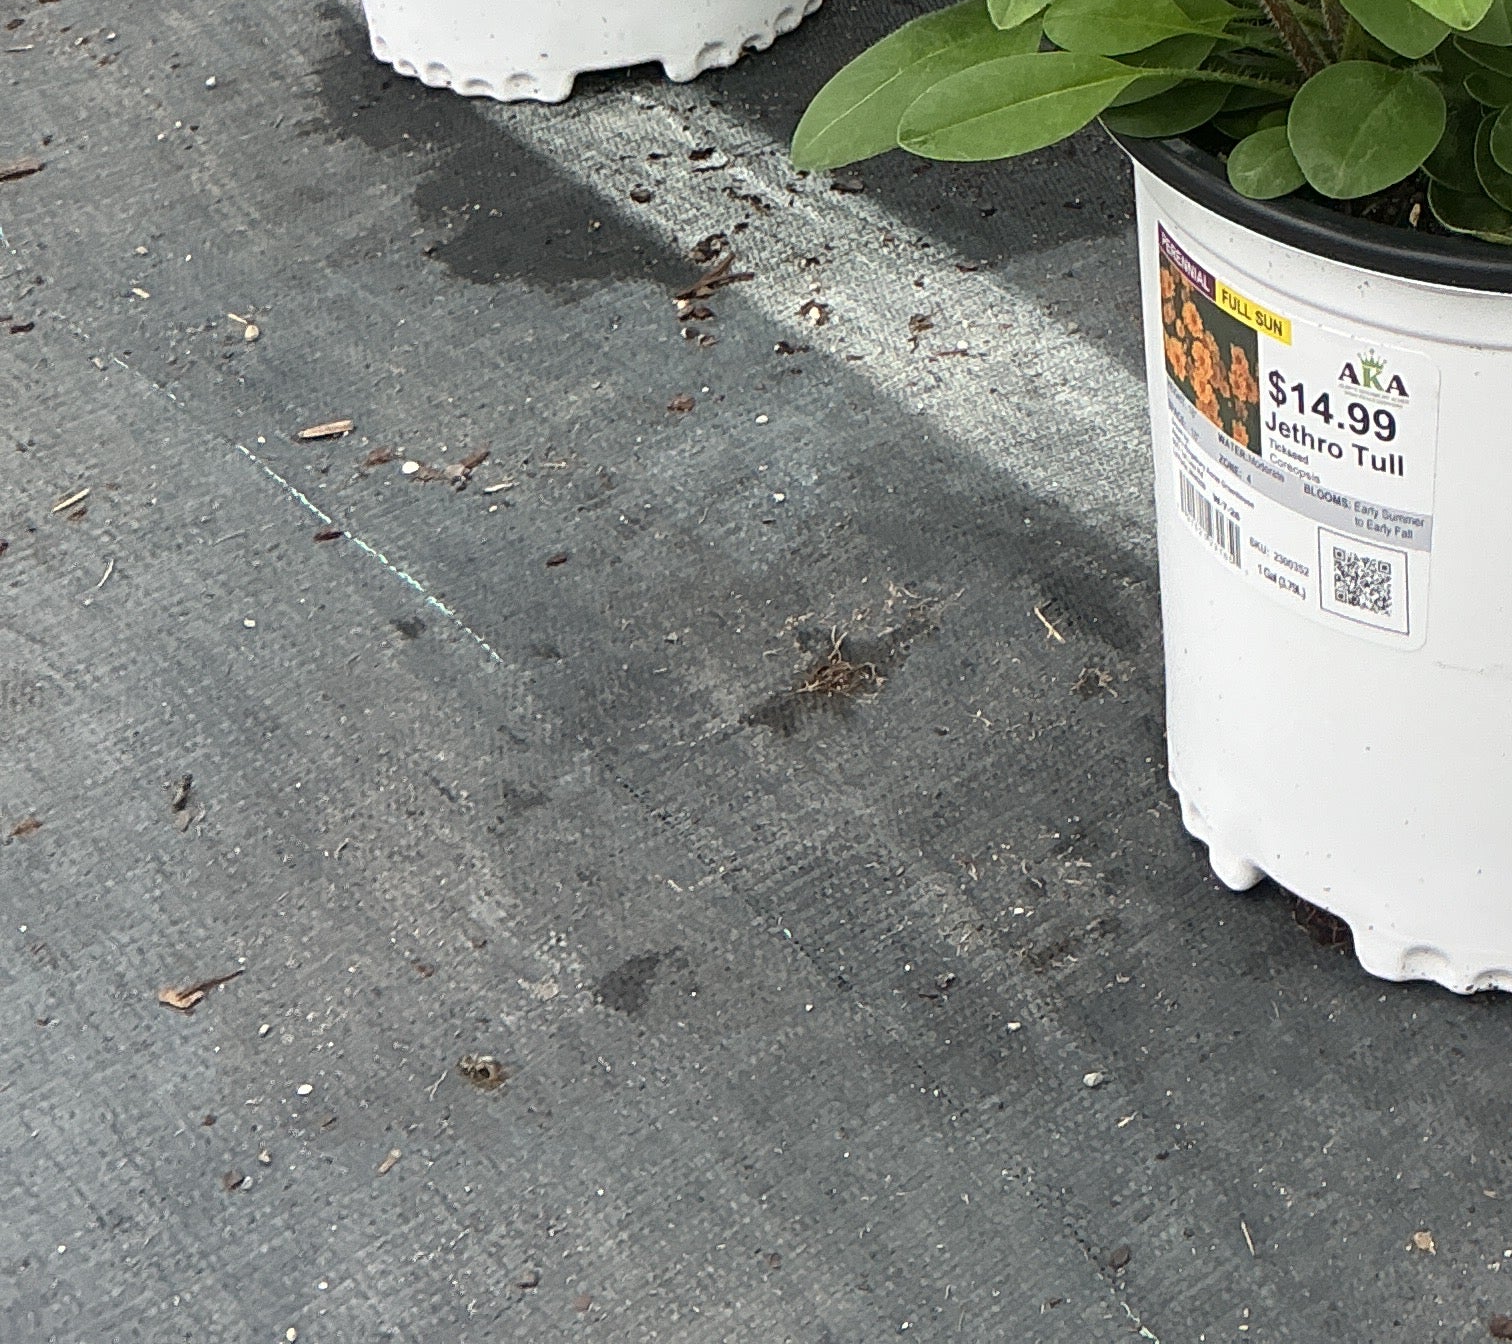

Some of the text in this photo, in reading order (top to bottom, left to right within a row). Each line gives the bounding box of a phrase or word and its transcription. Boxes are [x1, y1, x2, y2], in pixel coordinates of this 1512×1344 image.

[1161, 230, 1283, 338] PERENNIAL FULL SUN
[1268, 369, 1397, 443] $14.99
[1337, 361, 1410, 399] AKA
[1265, 411, 1404, 478] Jethro Tull
[1303, 483, 1351, 509] BLOOMS:
[1353, 501, 1379, 519] Early
[1394, 526, 1414, 540] Fall
